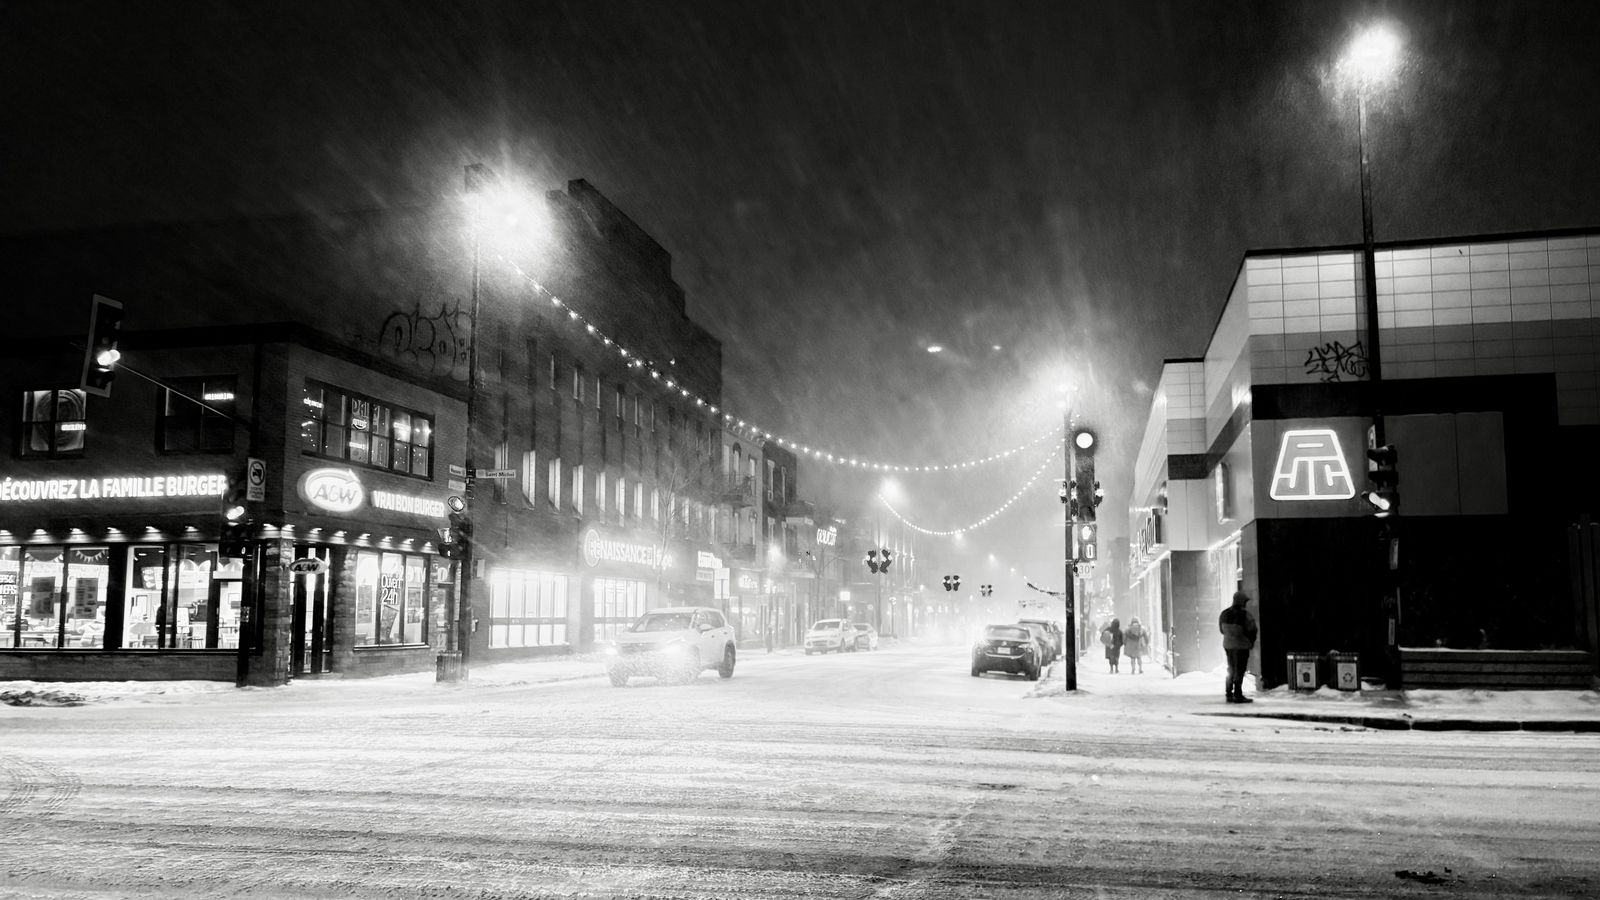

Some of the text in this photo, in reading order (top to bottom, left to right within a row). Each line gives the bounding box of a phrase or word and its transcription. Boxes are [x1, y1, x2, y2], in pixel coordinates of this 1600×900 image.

[80, 479, 100, 498] LA
[102, 477, 165, 497] FAMILLE
[166, 475, 227, 496] BURGER
[313, 484, 357, 504] A&W
[373, 490, 445, 518] VRAI BON BURGER
[588, 538, 647, 564] RENAISSANCE
[293, 563, 319, 572] A&W
[1079, 565, 1090, 574] 30
[381, 588, 398, 605] 24h
